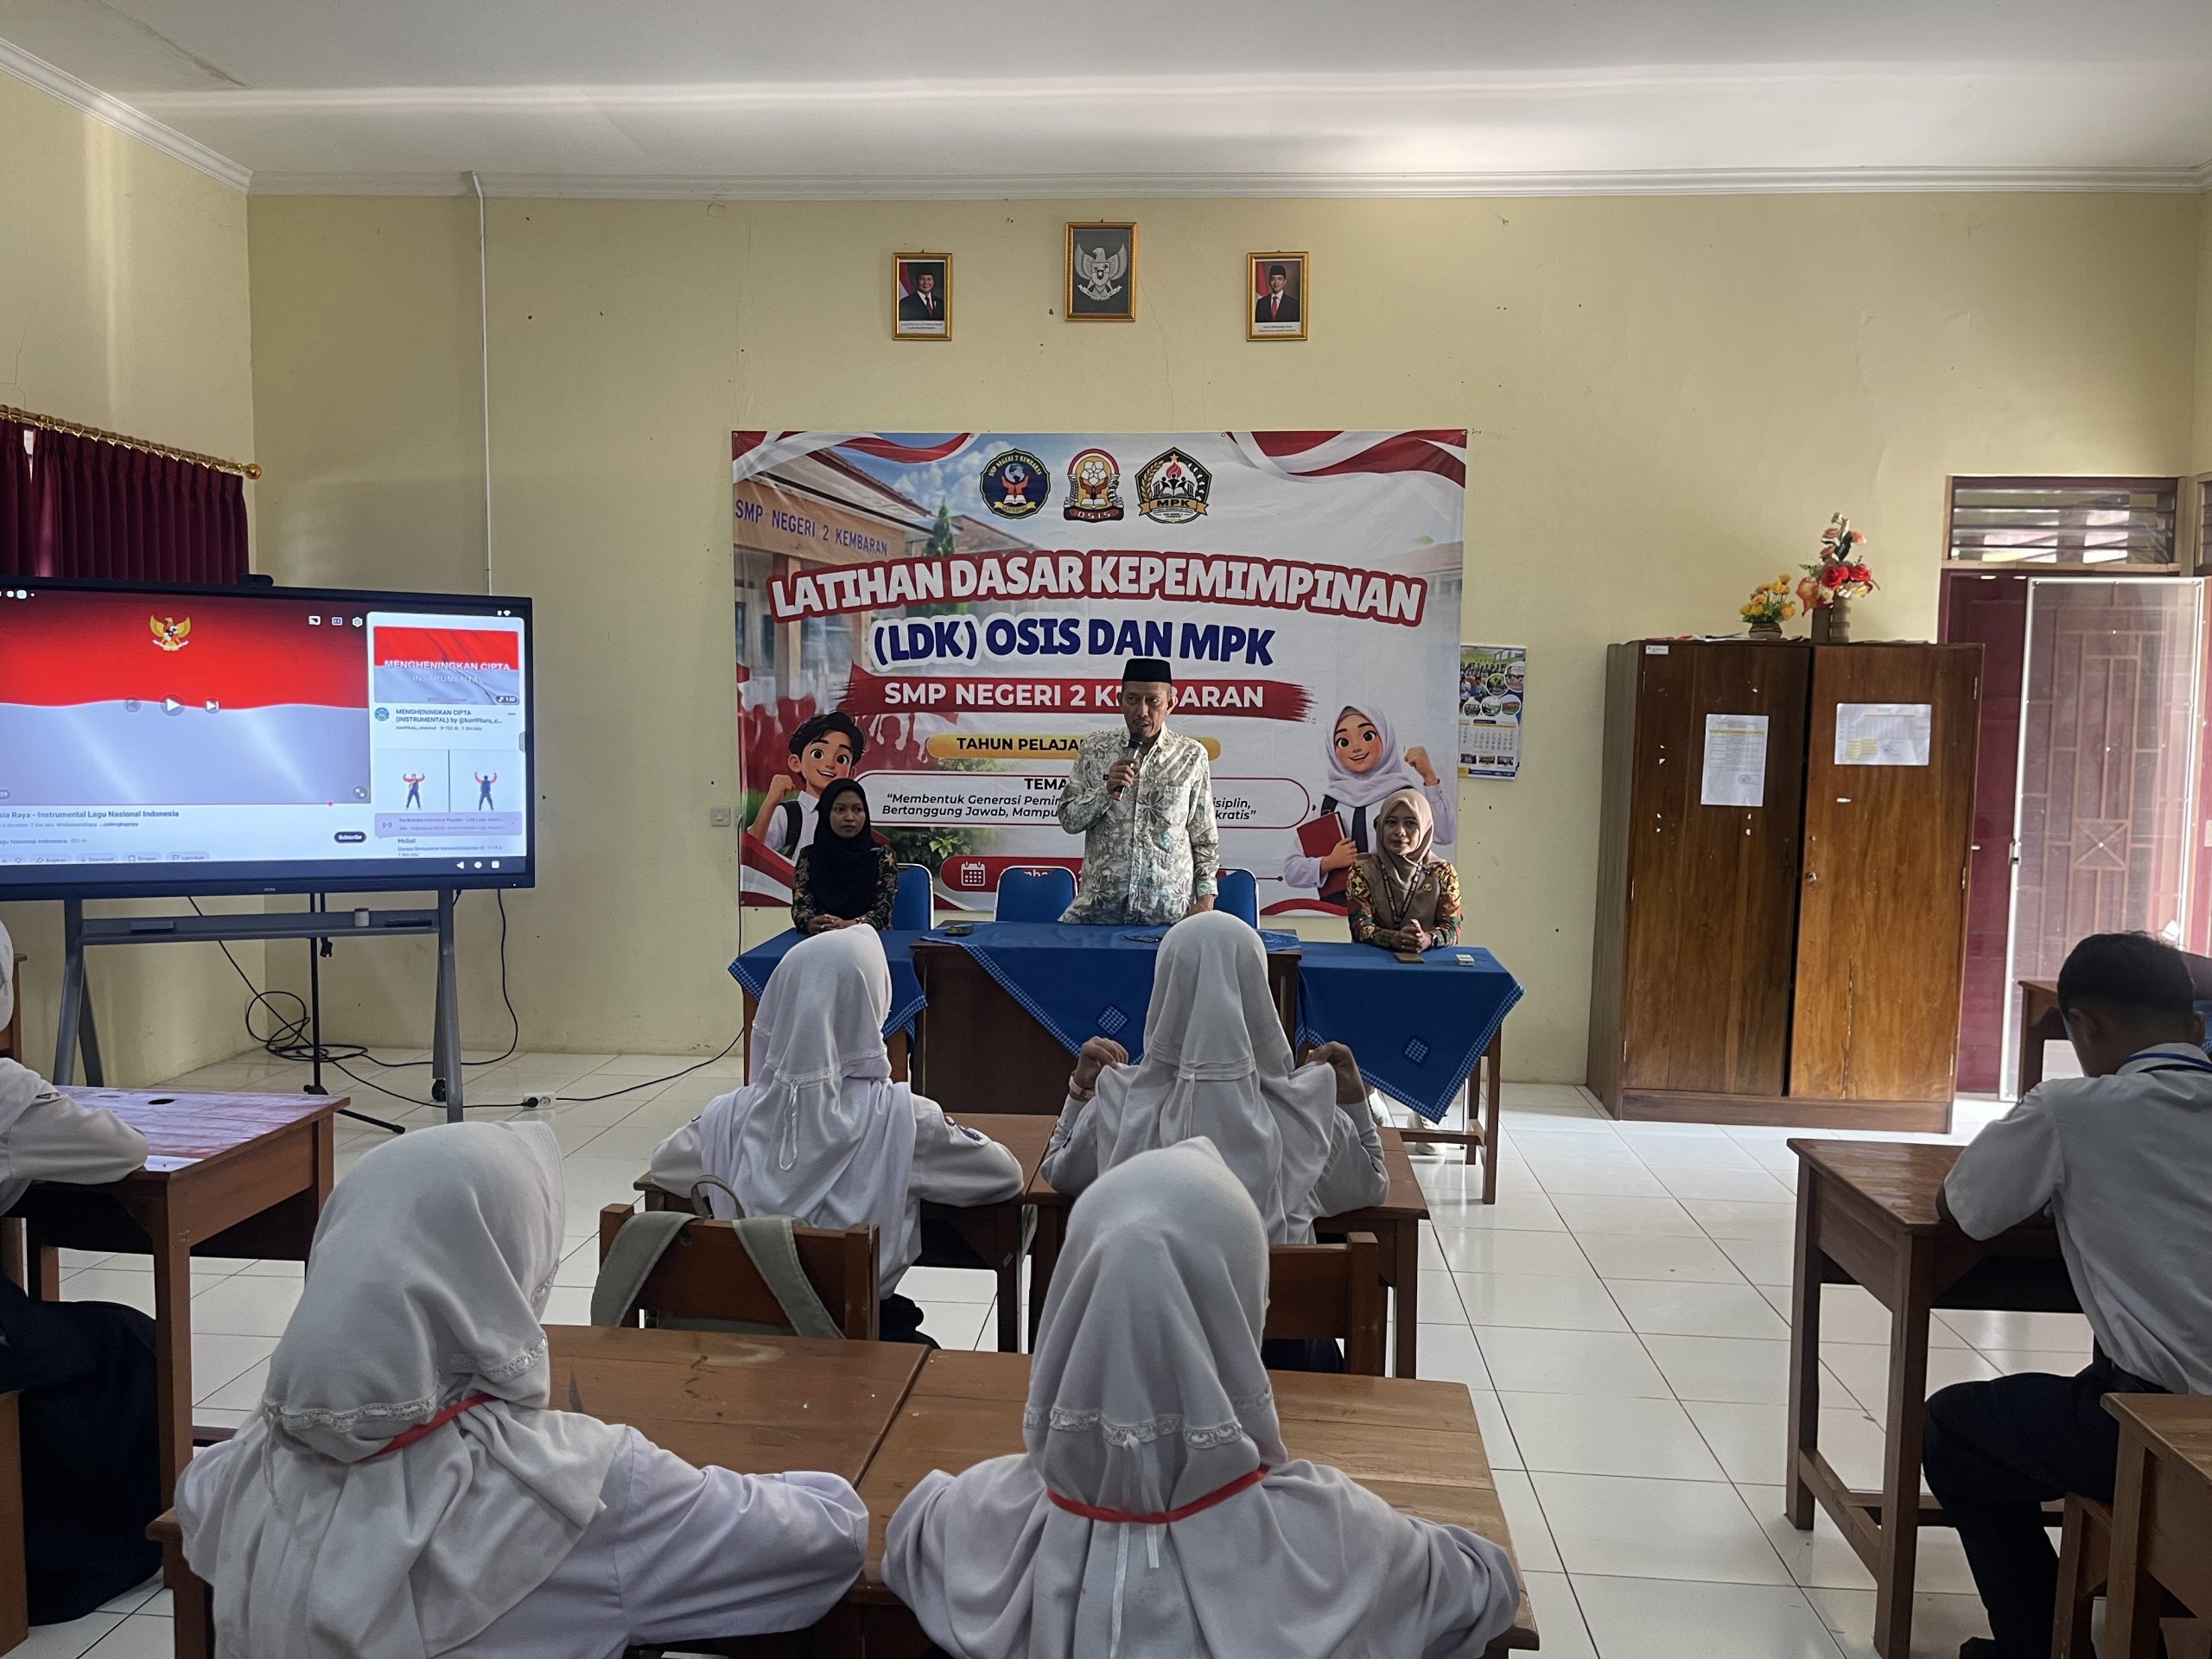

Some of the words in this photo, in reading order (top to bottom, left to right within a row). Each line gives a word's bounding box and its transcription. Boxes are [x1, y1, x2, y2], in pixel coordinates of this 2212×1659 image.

[735, 499, 764, 524] SMP
[772, 509, 816, 537] NEGERI
[823, 524, 830, 541] 2
[836, 528, 887, 556] KEMBARAN
[771, 561, 945, 619] LATIHAN
[950, 556, 1085, 597] DASAR
[1090, 556, 1421, 621] KEPEMIMPINAN
[874, 620, 977, 666] (LDK)
[986, 618, 1081, 656] OSIS
[1088, 619, 1173, 658] DAN
[1179, 622, 1275, 666] MPK
[384, 659, 478, 671] MENGHENINGKAN
[480, 662, 511, 671] CIPTA
[412, 674, 482, 683] INSTRUMENTAL
[884, 682, 947, 706] SMP
[956, 683, 1061, 707] NEGERI
[1070, 684, 1086, 707] 2
[957, 737, 1014, 751] TAHUN
[1019, 739, 1084, 751] PELAJA
[1024, 778, 1067, 791] TEMA
[968, 794, 1021, 805] Generasi
[1213, 797, 1251, 810] isiplin,
[88, 810, 107, 819] Lagu
[882, 804, 963, 818] Bertanggung
[965, 806, 1008, 818] Jawab,
[1012, 807, 1058, 819] Mampu
[1216, 810, 1257, 820] kratis”
